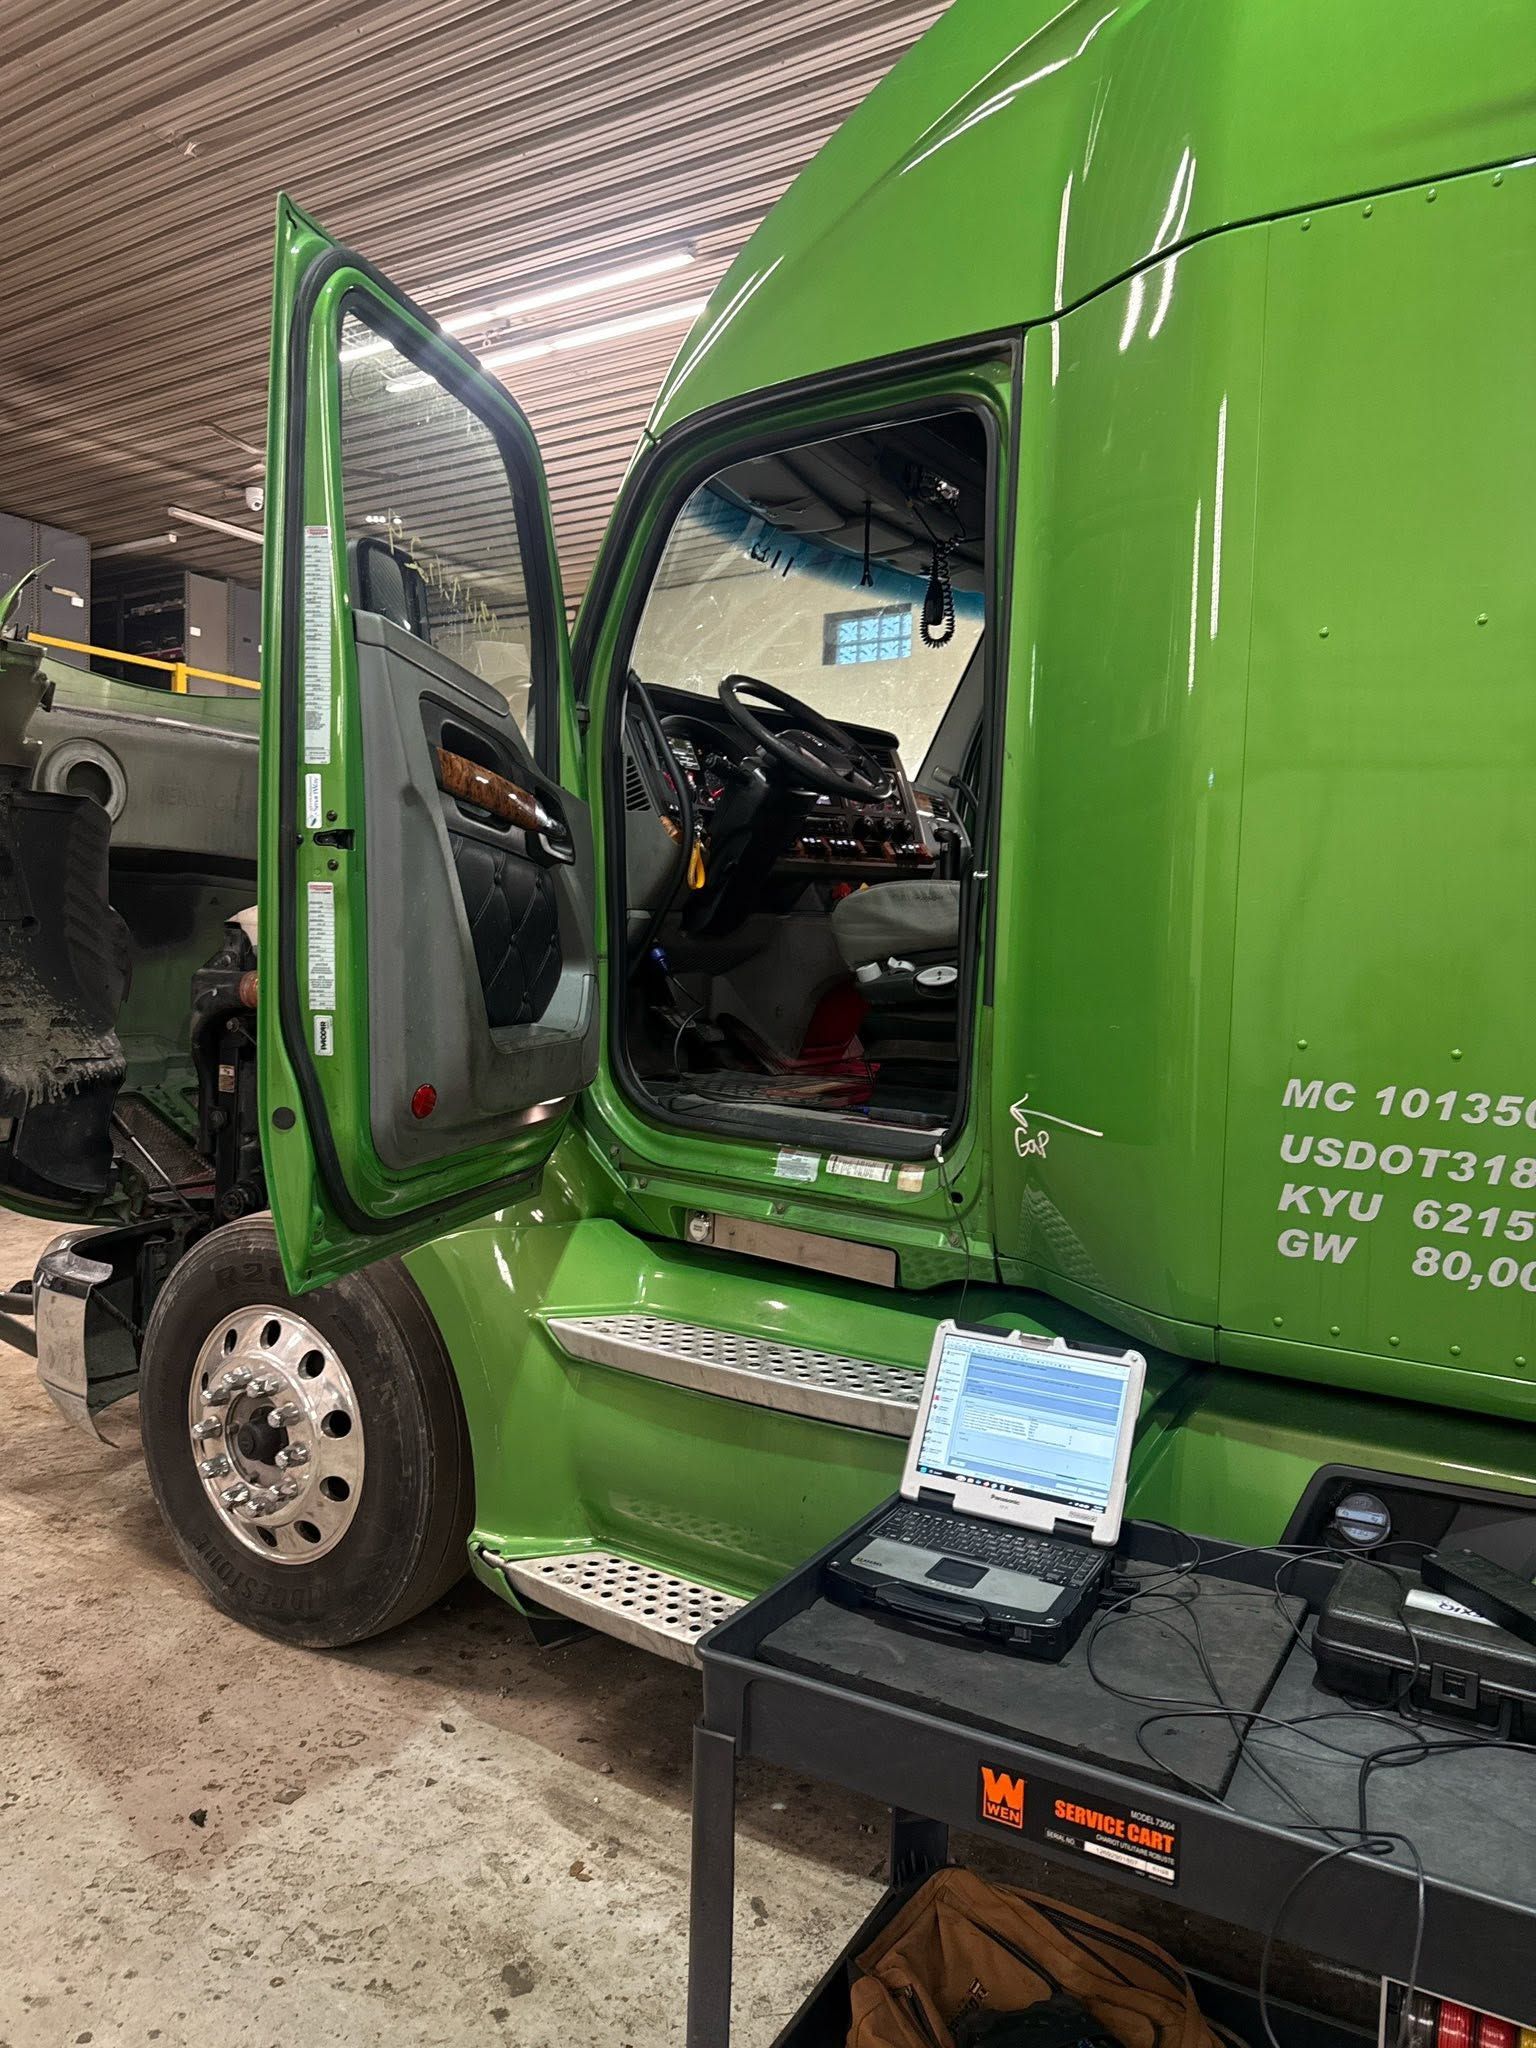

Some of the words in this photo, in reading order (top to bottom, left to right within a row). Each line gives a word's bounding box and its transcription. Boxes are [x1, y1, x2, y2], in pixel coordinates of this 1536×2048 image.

[1281, 1078, 1357, 1112] MC
[1279, 1134, 1536, 1189] USDOT318
[1277, 1183, 1384, 1222] KYU
[1412, 1199, 1536, 1242] 6215
[1277, 1228, 1358, 1265] GW
[986, 1801, 1020, 1823] WEN
[1054, 1799, 1125, 1839] SERVICE
[1127, 1822, 1175, 1854] CART
[1130, 1810, 1155, 1825] MODEL
[1046, 1829, 1065, 1843] SERIAL
[1095, 1833, 1119, 1847] CHARIOT
